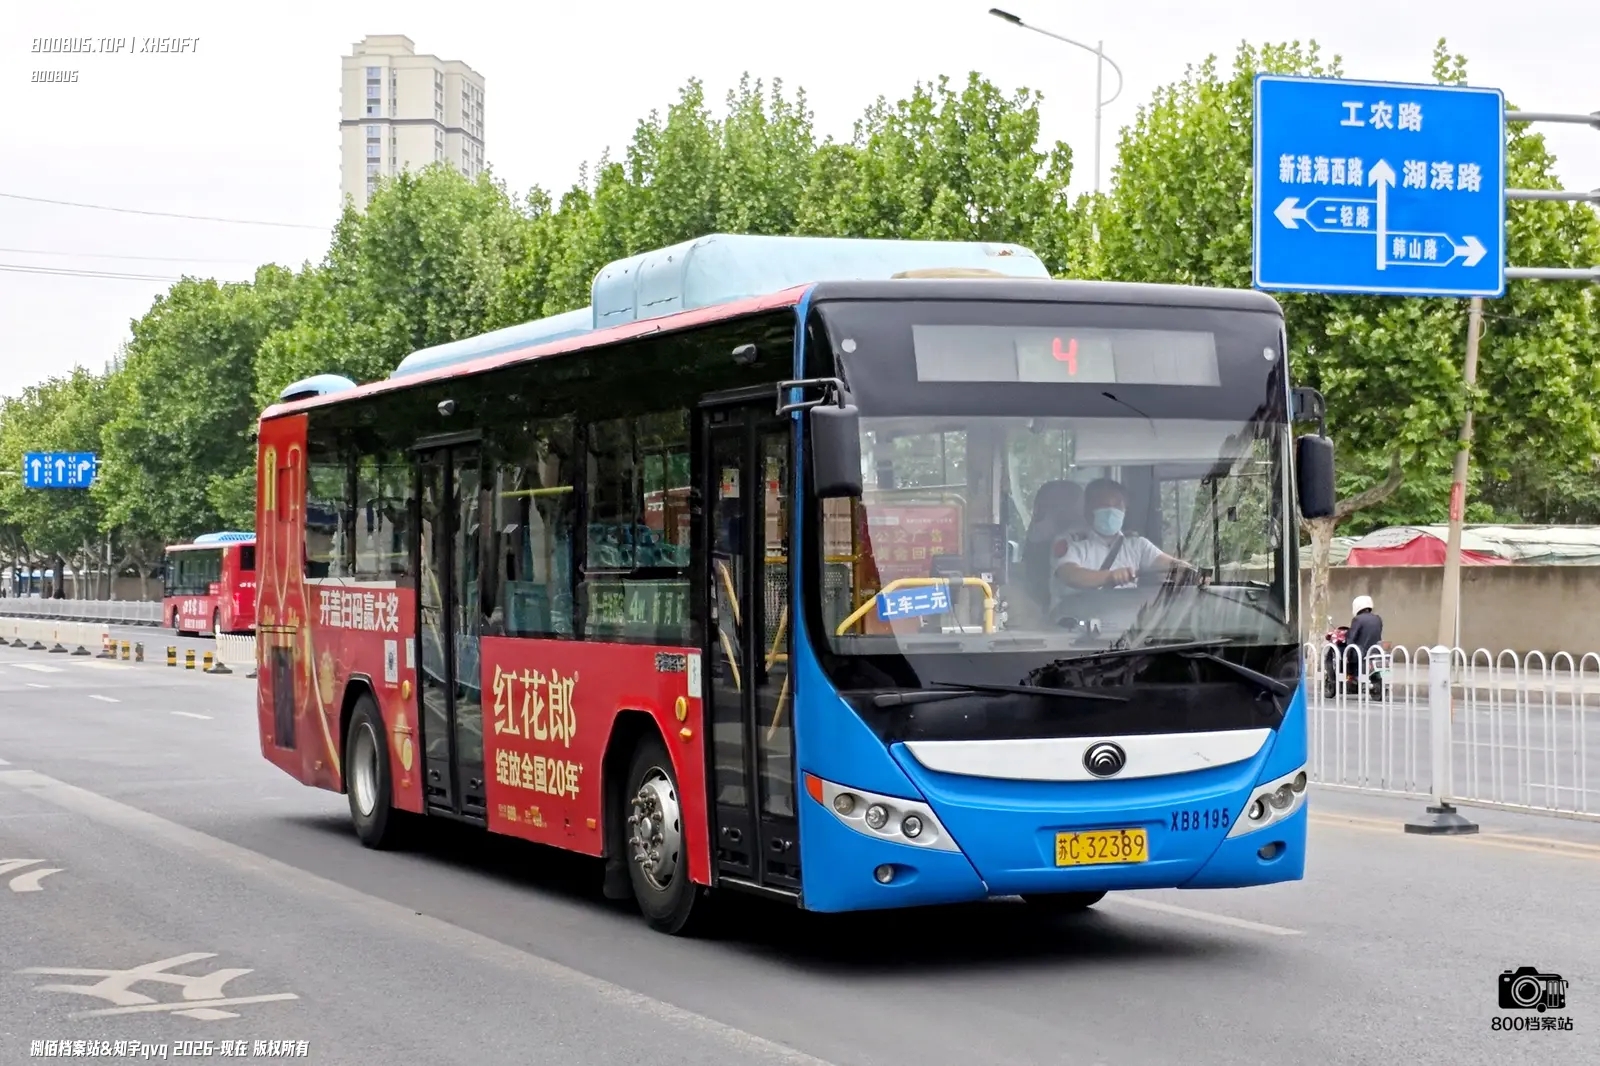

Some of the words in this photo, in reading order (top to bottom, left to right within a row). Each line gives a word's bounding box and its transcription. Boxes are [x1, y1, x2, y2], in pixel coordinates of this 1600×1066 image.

[1340, 101, 1423, 132] 工农路
[1279, 153, 1363, 187] 新淮海西路
[1402, 159, 1482, 193] 湖滨路
[1323, 204, 1370, 228] 二轻路
[1392, 236, 1438, 261] 韩山路
[1052, 337, 1077, 376] 4
[320, 589, 399, 633] 开盖扫码赢大奖
[882, 591, 948, 616] 上车二元
[1171, 808, 1230, 831] XB8195
